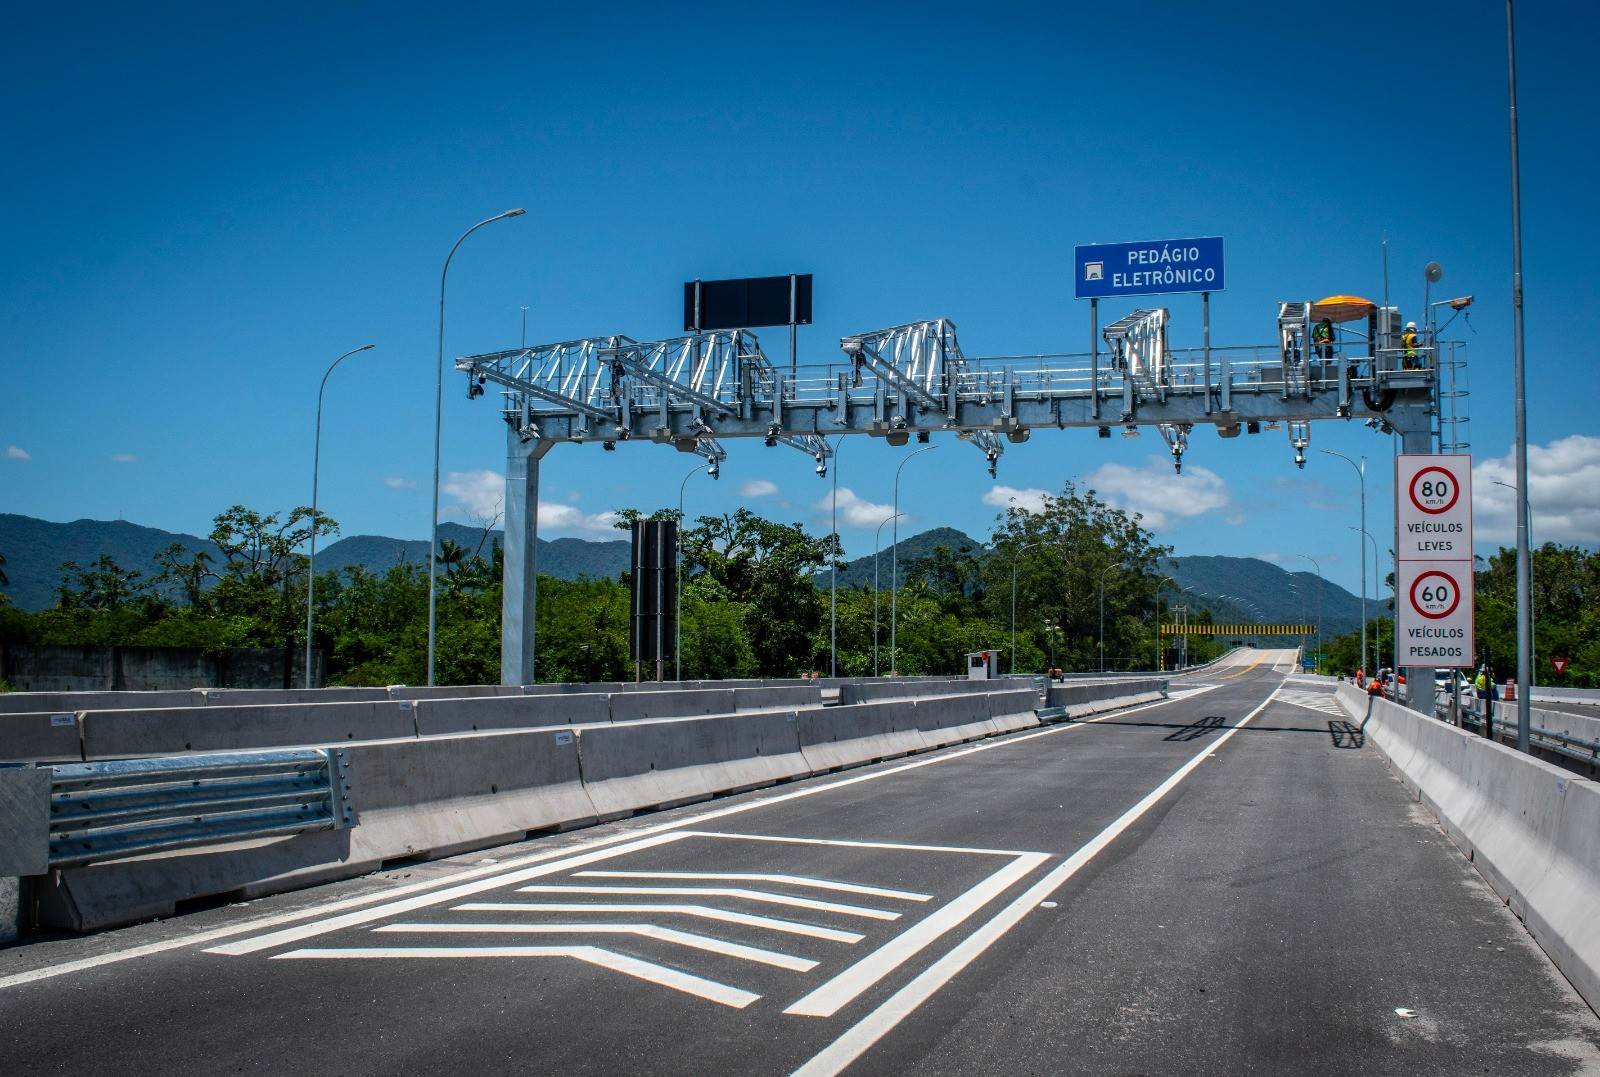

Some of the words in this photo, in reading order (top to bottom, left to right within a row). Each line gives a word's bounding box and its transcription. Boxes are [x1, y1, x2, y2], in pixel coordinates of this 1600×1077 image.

[1128, 244, 1199, 265] PEDÁGIO
[1113, 266, 1215, 287] ELETRÔNICO
[1421, 481, 1447, 497] 80
[1408, 521, 1463, 533] VEÍCULOS
[1418, 541, 1453, 551] LEVES
[1422, 586, 1448, 602] 60
[1408, 626, 1463, 638] VEÍCULOS
[1410, 646, 1463, 656] PESADOS
